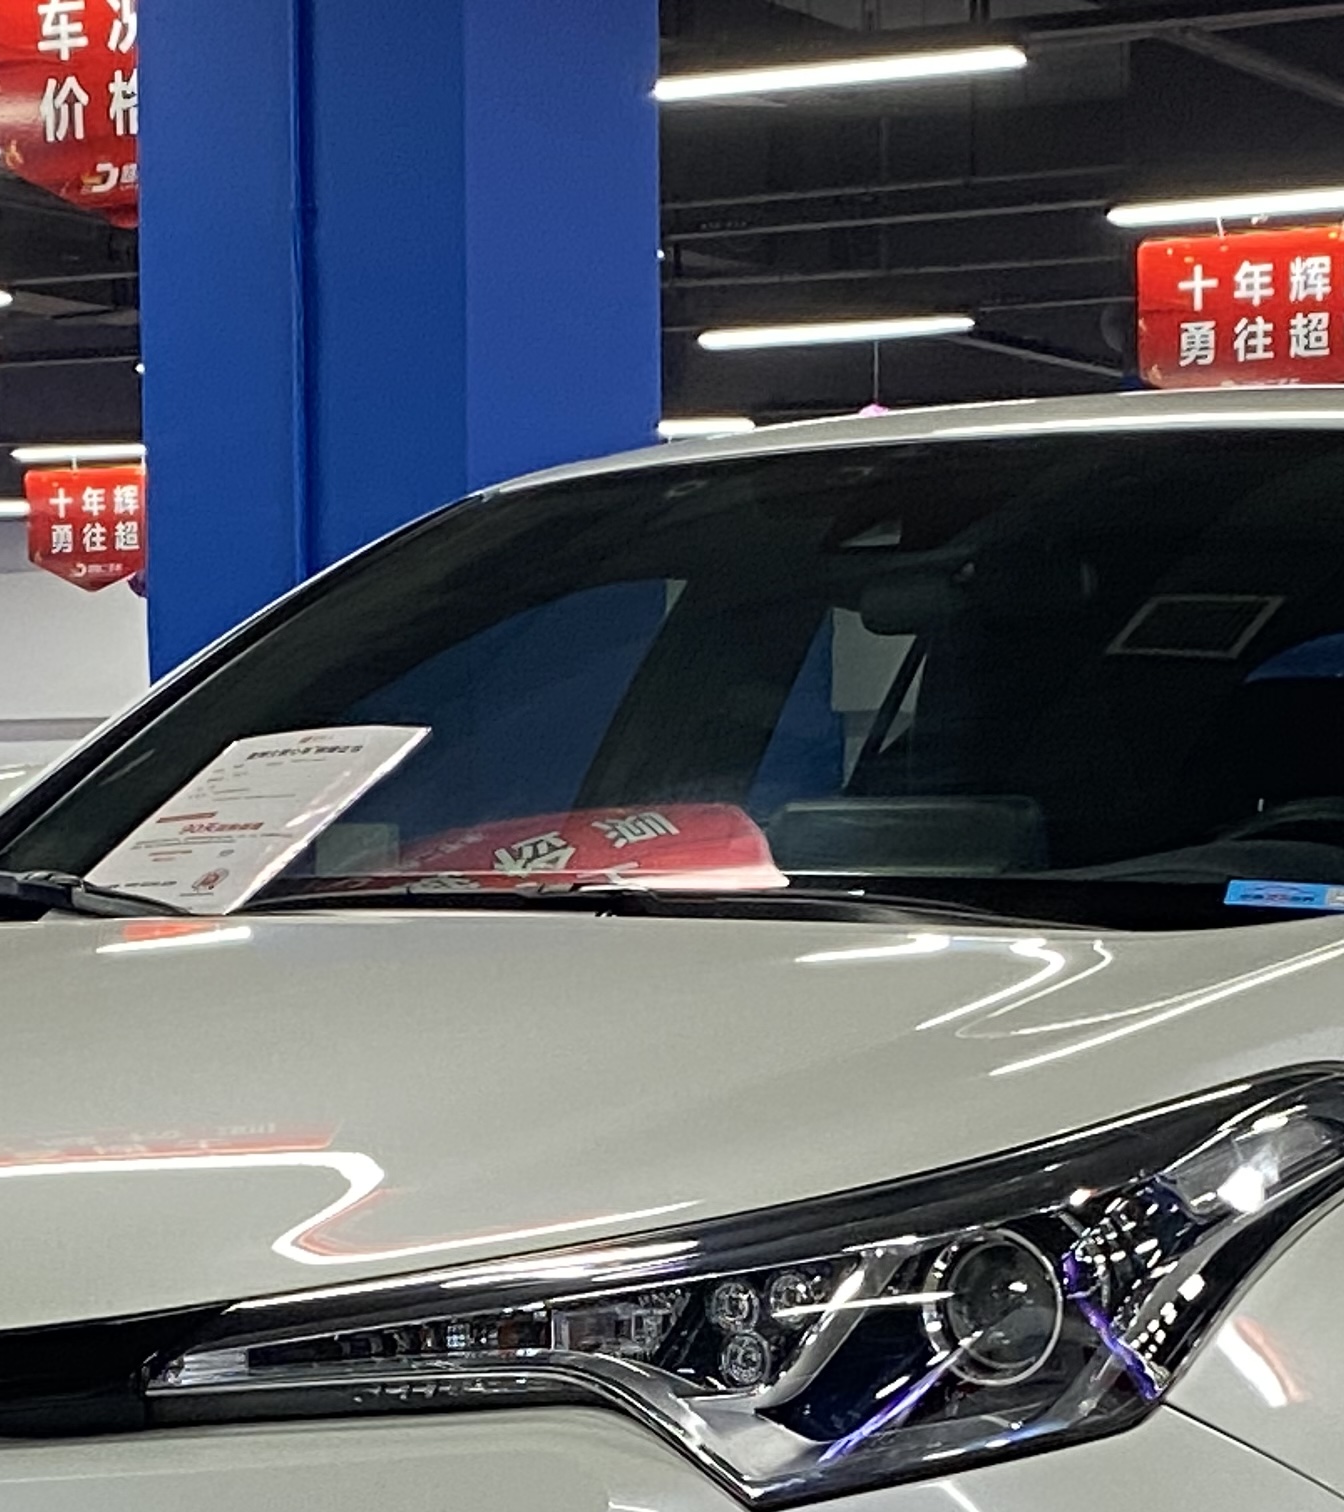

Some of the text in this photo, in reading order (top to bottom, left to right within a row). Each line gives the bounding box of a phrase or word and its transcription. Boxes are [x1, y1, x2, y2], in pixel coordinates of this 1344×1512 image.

[49, 485, 140, 519] 十年辉
[50, 521, 140, 554] 勇往超
